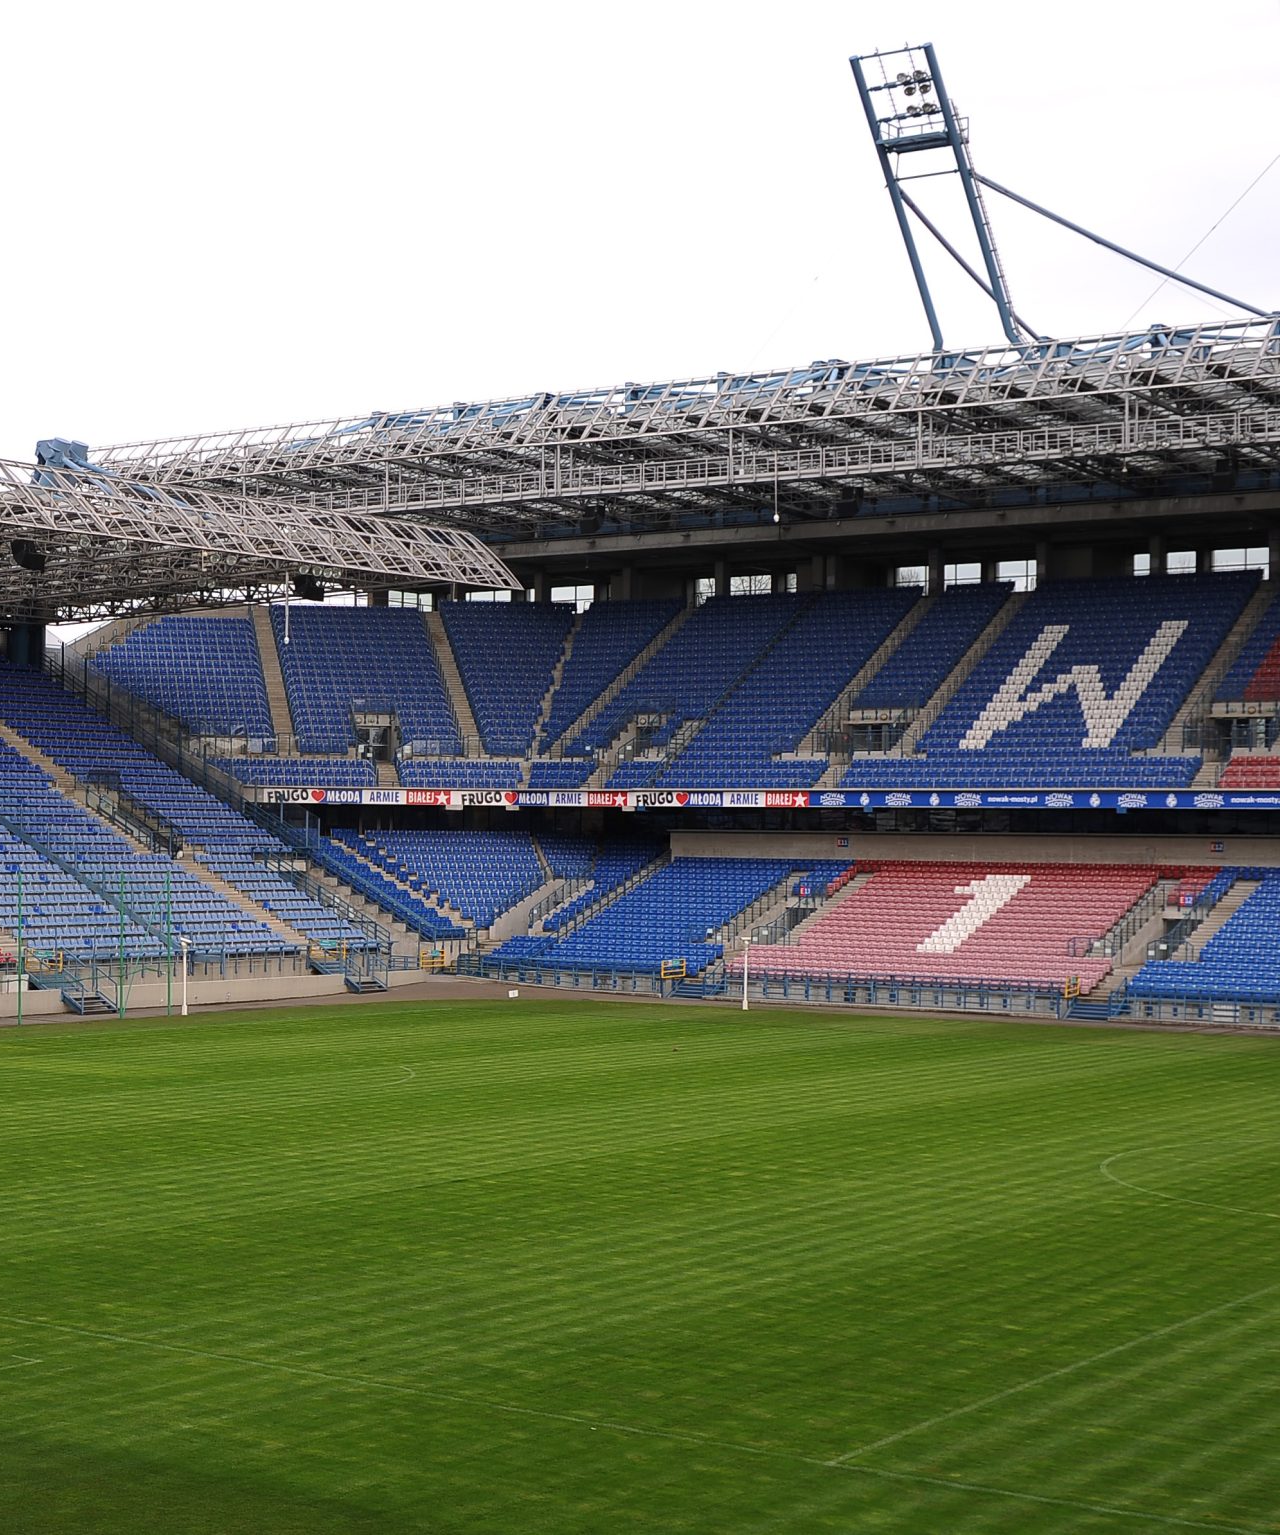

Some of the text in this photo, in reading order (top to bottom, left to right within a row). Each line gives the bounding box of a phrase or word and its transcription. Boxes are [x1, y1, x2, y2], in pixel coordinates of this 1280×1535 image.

[959, 620, 1188, 749] W
[267, 789, 309, 802] FRUGO
[409, 791, 434, 803] BIAŁEJ
[461, 791, 502, 805] FRUGO
[589, 793, 613, 805] BIAŁEJ
[636, 792, 673, 805] FRUGO
[767, 793, 792, 805] BIAŁEJ
[820, 792, 845, 801] NOWAK
[885, 792, 911, 801] NOWAK
[954, 792, 982, 801] NOWAK
[1045, 793, 1073, 801] NOWAK
[1118, 793, 1147, 801] NOWAK
[1194, 793, 1224, 801] NOWAK
[916, 875, 1031, 952] 1
